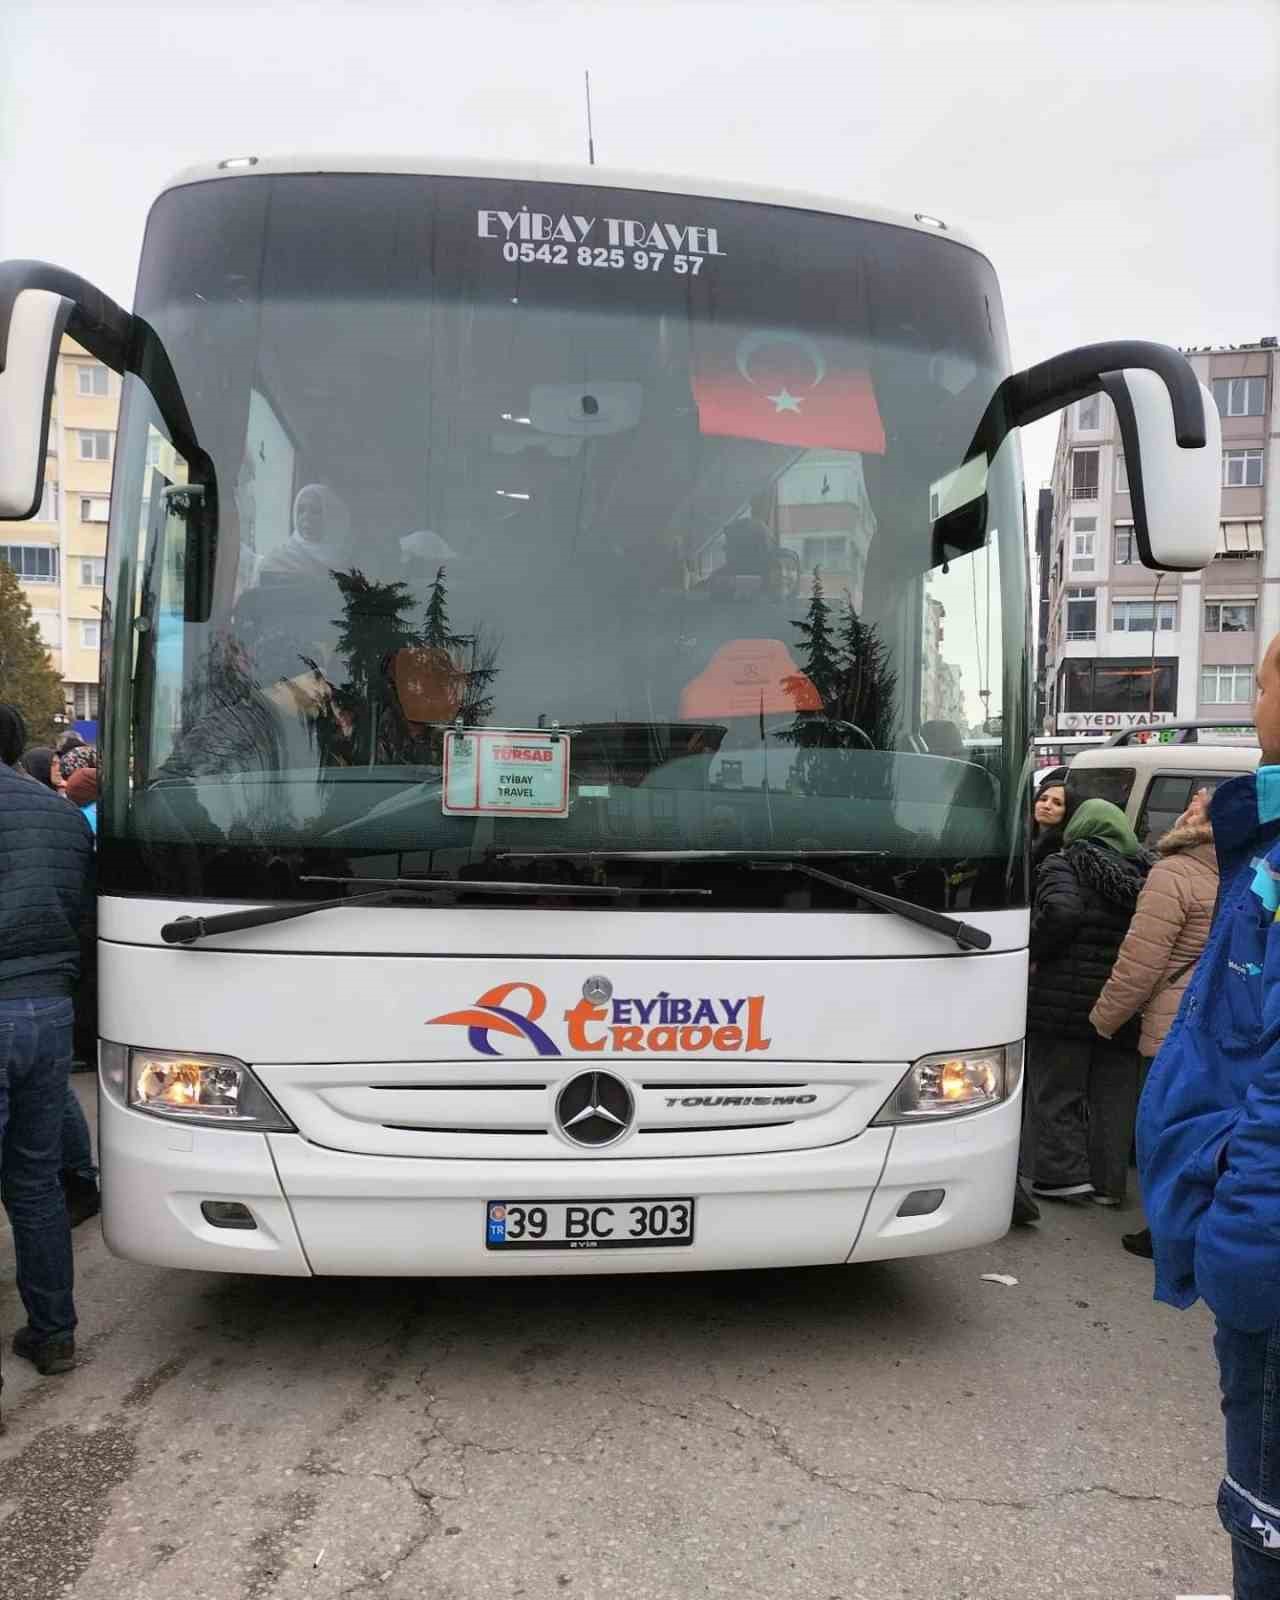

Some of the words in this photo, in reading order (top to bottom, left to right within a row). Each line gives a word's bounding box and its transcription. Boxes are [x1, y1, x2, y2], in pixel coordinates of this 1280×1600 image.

[477, 205, 596, 243] EYİBAY
[603, 217, 727, 256] TRAVEL
[502, 241, 569, 265] 0542
[577, 246, 626, 269] 825
[632, 250, 665, 273] 97
[673, 254, 704, 276] 57
[496, 787, 536, 798] TRAVEL
[611, 991, 747, 1025] EYİBAY
[663, 1094, 818, 1108] TOURISMO
[491, 1225, 504, 1236] TR
[506, 1207, 548, 1239] 39
[565, 1206, 615, 1239] BC
[628, 1204, 689, 1237] 303
